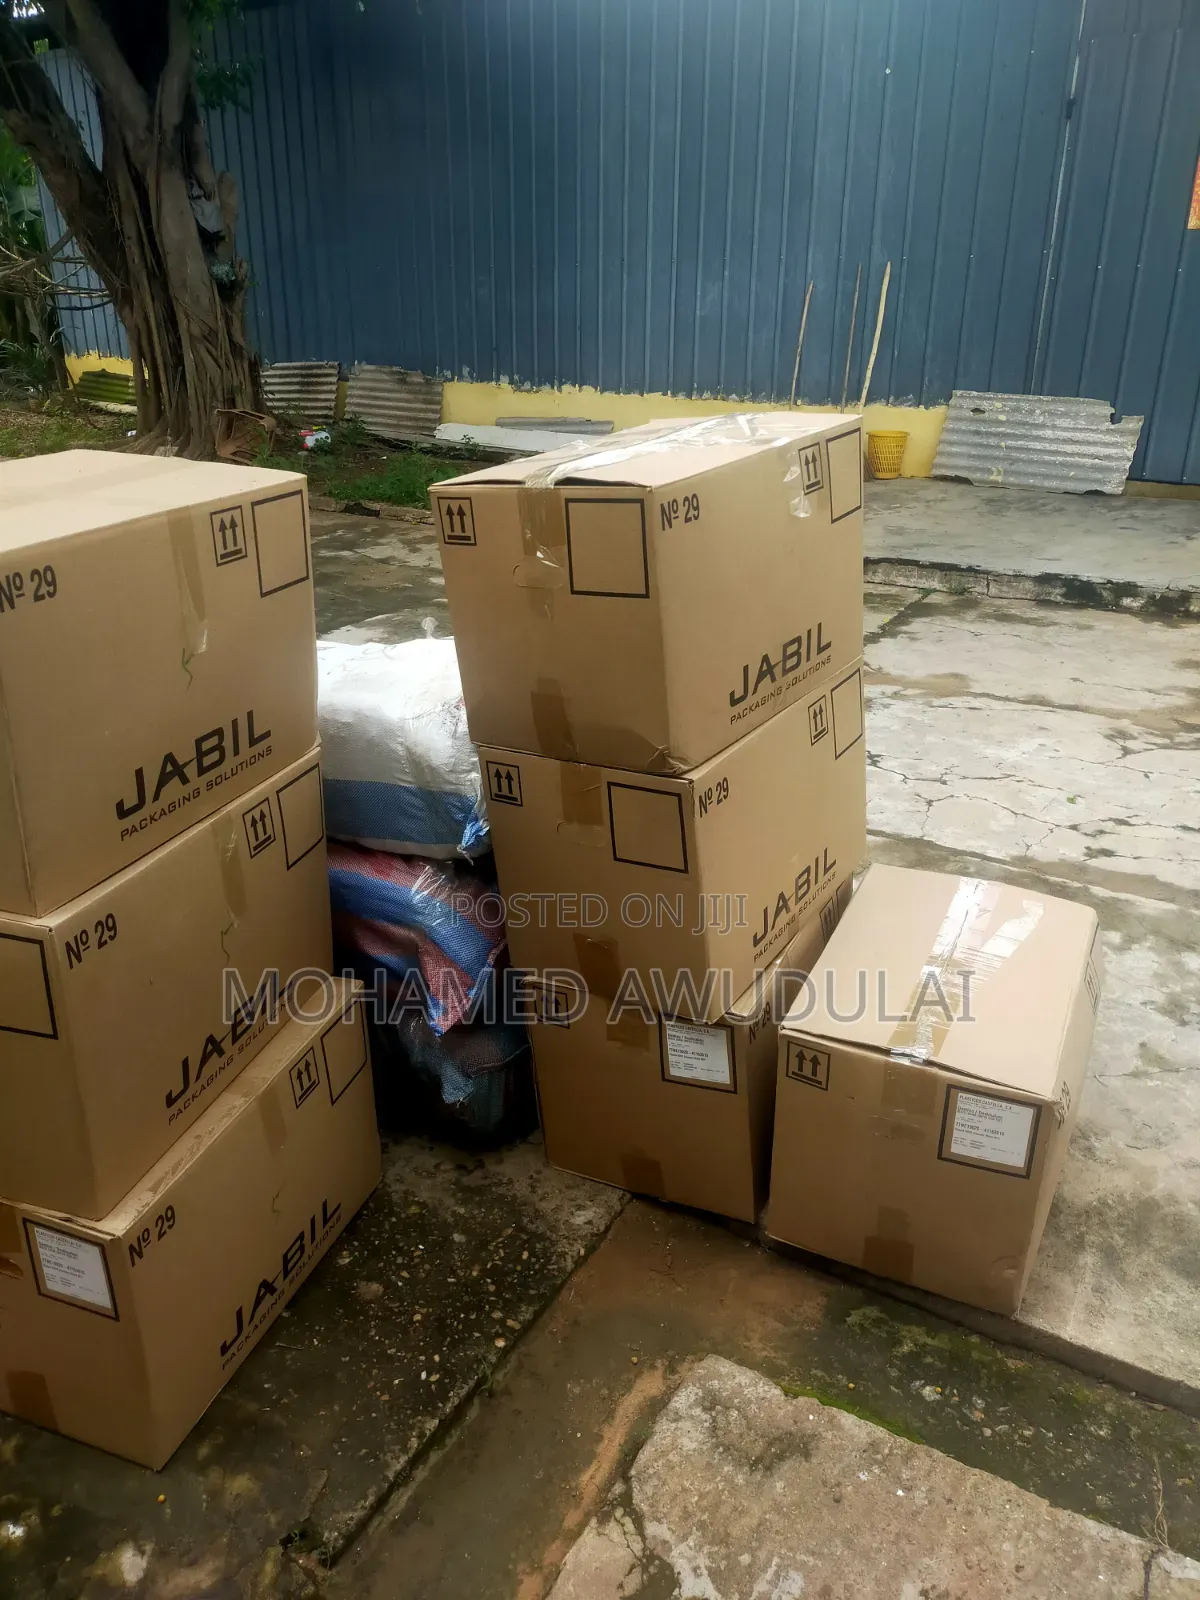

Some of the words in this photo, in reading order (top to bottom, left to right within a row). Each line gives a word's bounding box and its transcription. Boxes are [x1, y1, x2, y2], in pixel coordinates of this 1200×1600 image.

[682, 493, 700, 523] 29
[30, 565, 58, 602] 29
[729, 622, 832, 707] JABIL
[730, 686, 783, 725] PACKAGING
[785, 654, 832, 691] SOLUTIONS
[115, 709, 272, 820] JABIL
[120, 786, 201, 842] PACKAGING
[206, 745, 273, 791] SOLUTIONS
[715, 777, 729, 805] 29
[94, 913, 117, 950] 29
[752, 847, 837, 948] JABIL
[753, 914, 796, 963] PACKAGING
[798, 871, 836, 916] SOLUTIONS
[168, 1054, 234, 1126] PACKAGING
[155, 1204, 176, 1242] 29
[220, 1198, 341, 1358] JABIL
[222, 1288, 285, 1371] PACKAGING
